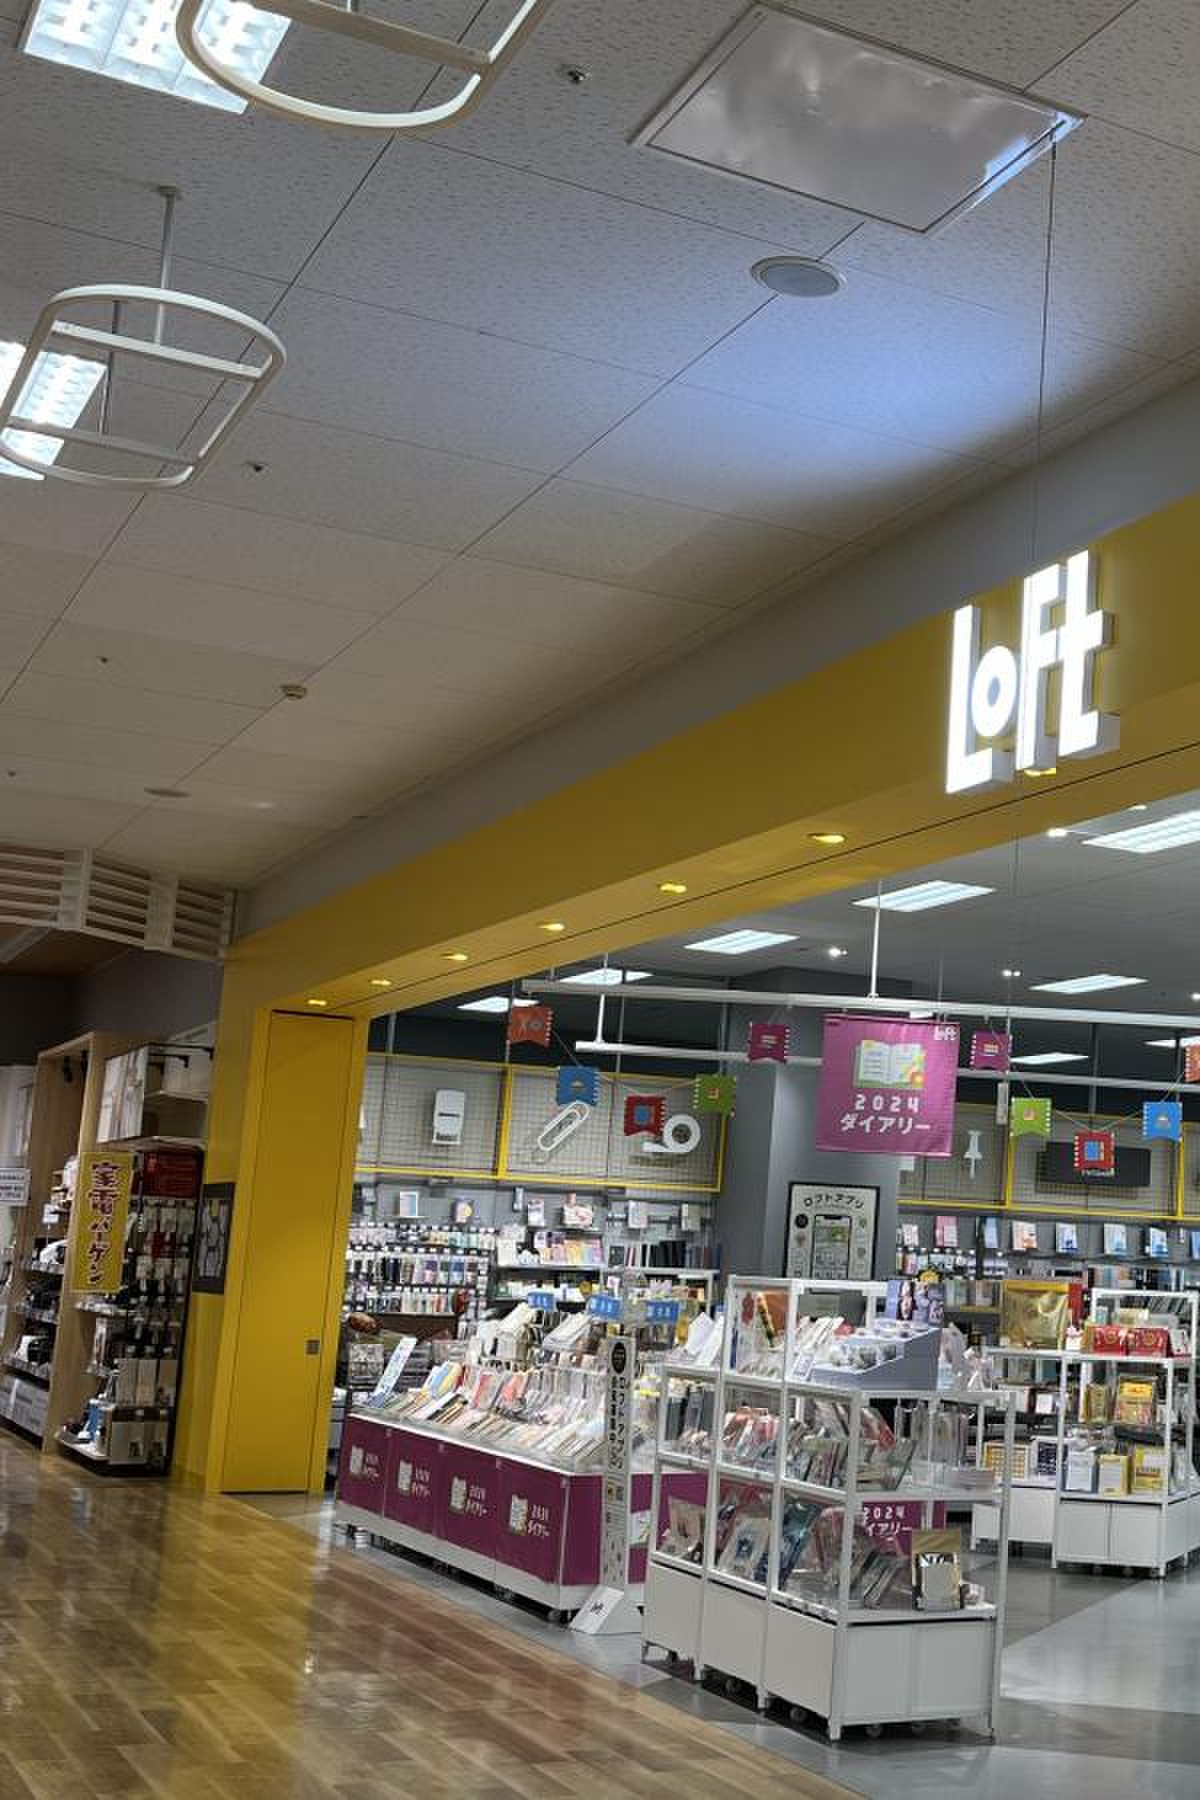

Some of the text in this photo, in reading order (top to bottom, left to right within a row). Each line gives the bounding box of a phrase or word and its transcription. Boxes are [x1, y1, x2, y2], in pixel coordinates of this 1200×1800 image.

[854, 1093, 919, 1113] 2024
[840, 1112, 931, 1135] ダイアリー
[803, 1193, 864, 1209] ロフトアプリ
[866, 1521, 913, 1537] イアリー
